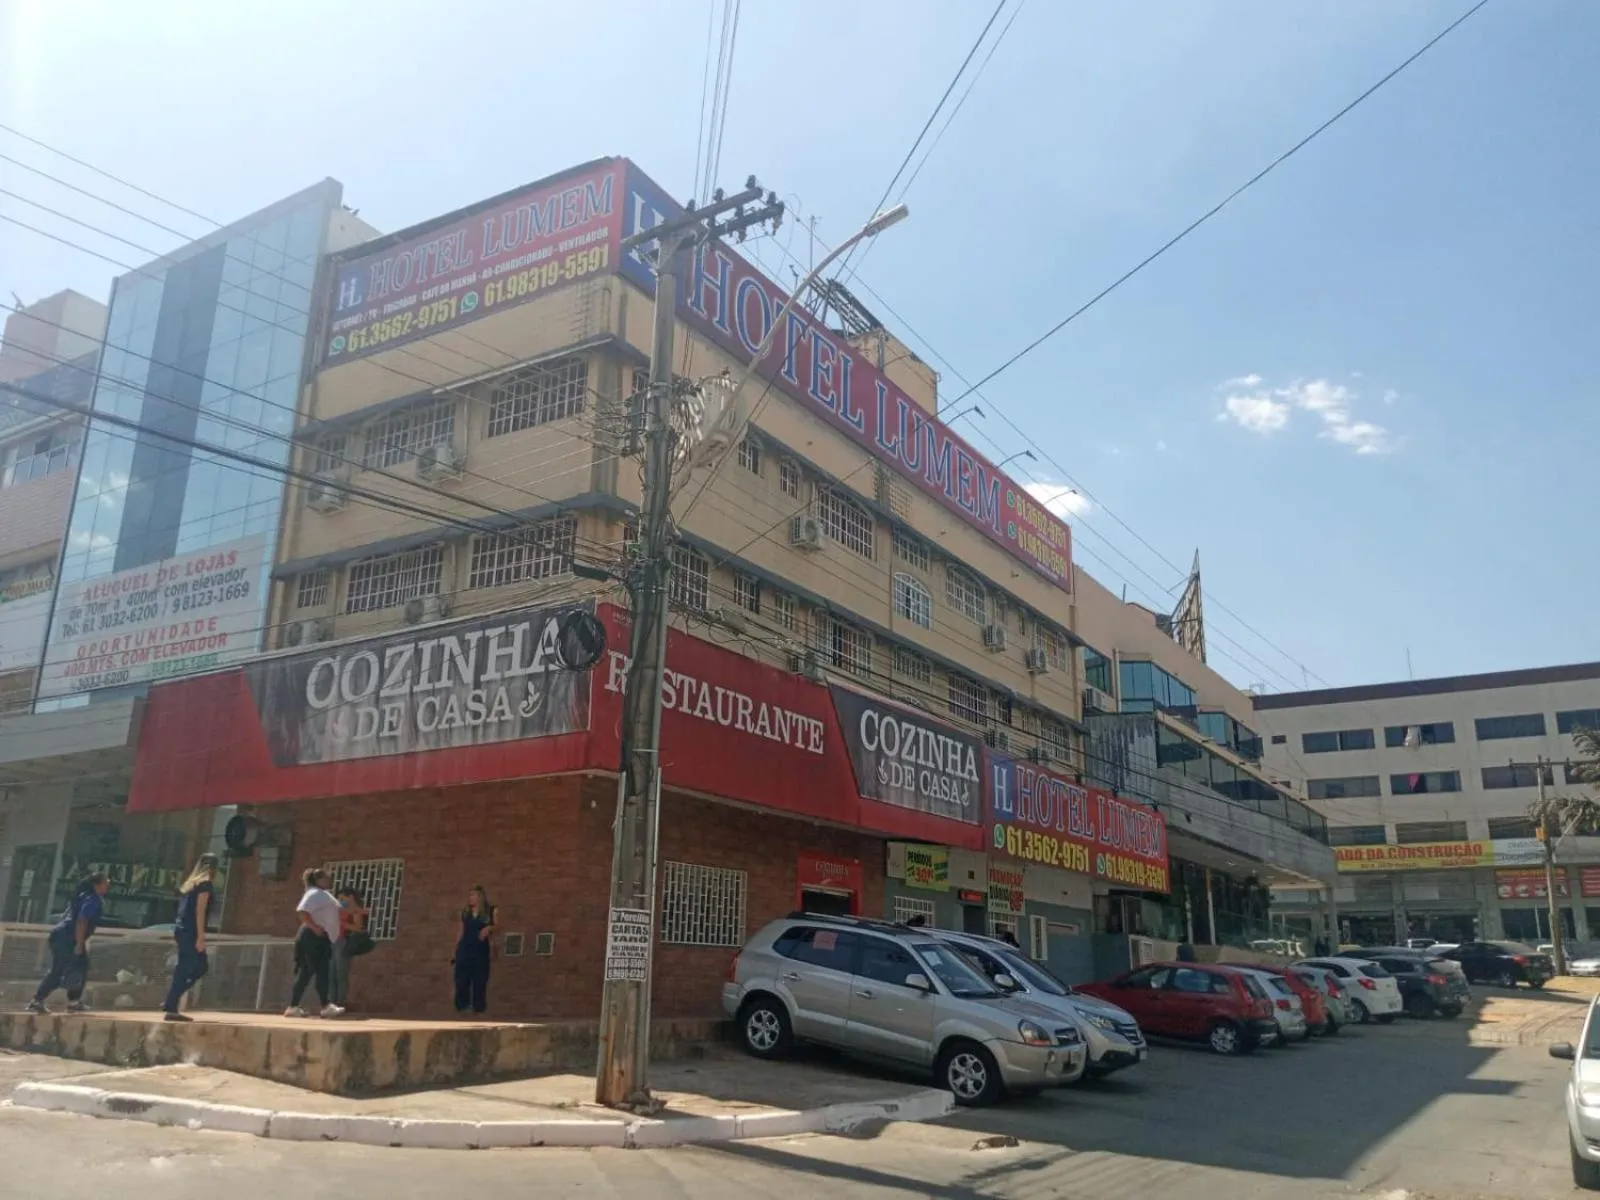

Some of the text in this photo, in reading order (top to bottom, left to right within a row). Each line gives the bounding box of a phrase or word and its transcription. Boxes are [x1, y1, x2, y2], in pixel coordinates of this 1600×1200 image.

[366, 229, 473, 300] HOTEL
[481, 173, 615, 260] LUMEM
[688, 243, 864, 434] HOTEL
[873, 378, 1004, 537] LUMEM
[82, 571, 149, 602] ALUGUEL
[156, 563, 178, 584] DE
[185, 550, 239, 575] LOJAS
[164, 579, 189, 599] com
[191, 567, 248, 591] elevador
[121, 647, 150, 666] COM
[153, 632, 228, 660] ELEVADOR
[353, 686, 514, 742] DE CASA
[604, 648, 825, 755] RSTAURANTE
[860, 707, 980, 782] COZINHA
[889, 763, 960, 805] DE CASA
[1015, 764, 1094, 841] HOTEL
[1097, 794, 1163, 859] LUMEM
[1006, 824, 1090, 873] 61.3562-9751
[1388, 841, 1483, 860] CONSTRUÇÃO
